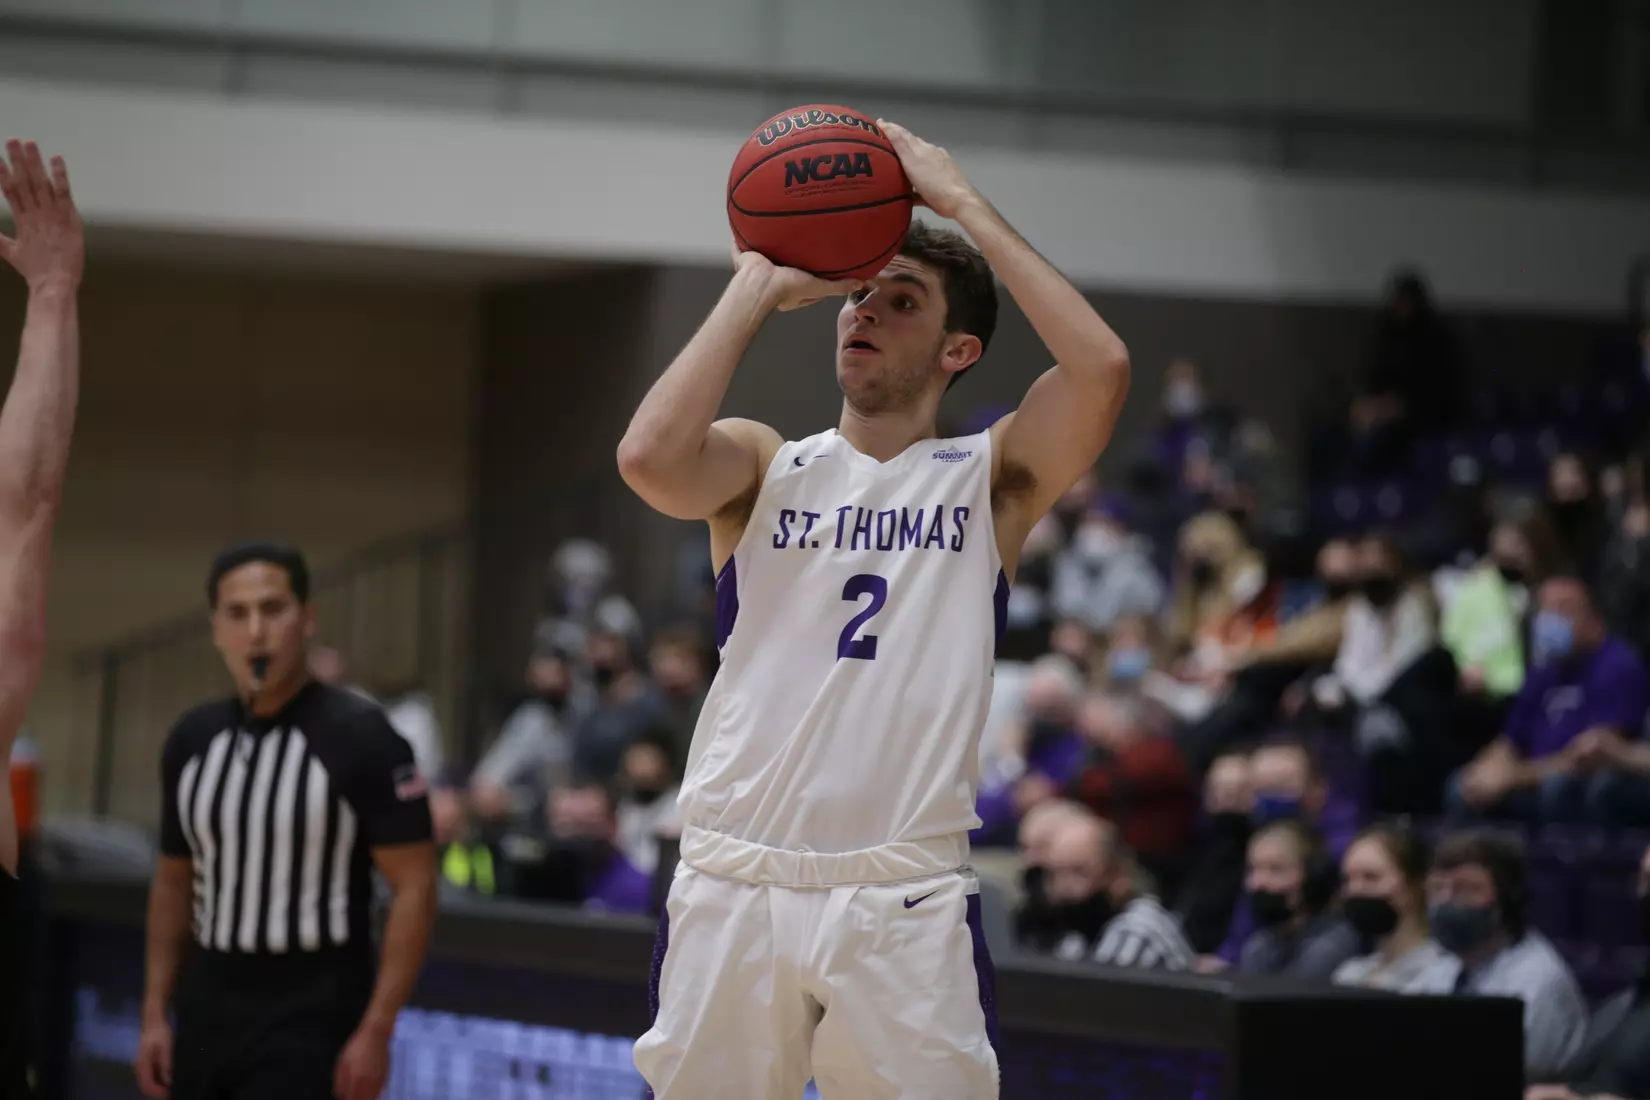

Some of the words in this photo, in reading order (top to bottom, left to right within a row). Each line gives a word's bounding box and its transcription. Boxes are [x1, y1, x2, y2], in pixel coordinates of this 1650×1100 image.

[784, 152, 874, 188] NCAA
[932, 451, 973, 460] SUMMIT
[773, 509, 821, 549] ST.
[834, 505, 970, 553] THOMAS
[836, 574, 888, 662] 2
